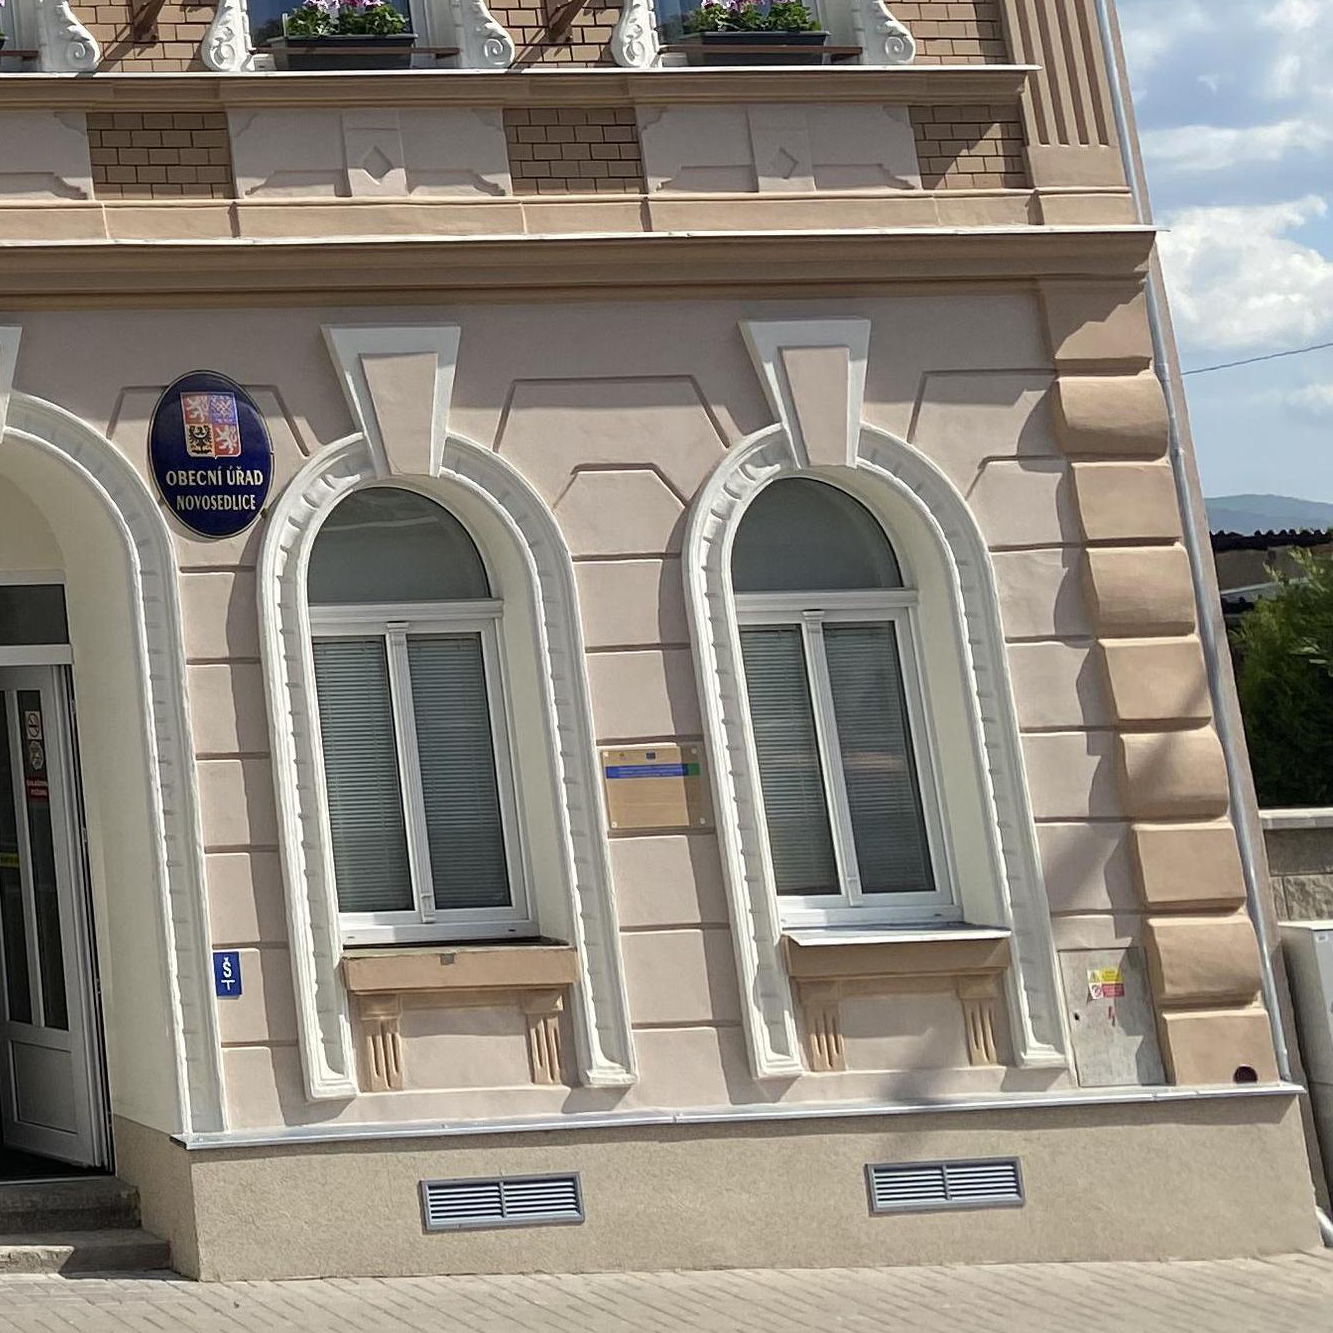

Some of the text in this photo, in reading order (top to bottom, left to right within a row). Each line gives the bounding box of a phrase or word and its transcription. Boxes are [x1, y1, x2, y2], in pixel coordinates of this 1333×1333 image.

[166, 465, 264, 486] OBECNÍ ÚŘAD
[176, 494, 257, 511] NOVOSEDLICE
[222, 956, 232, 978] Š
